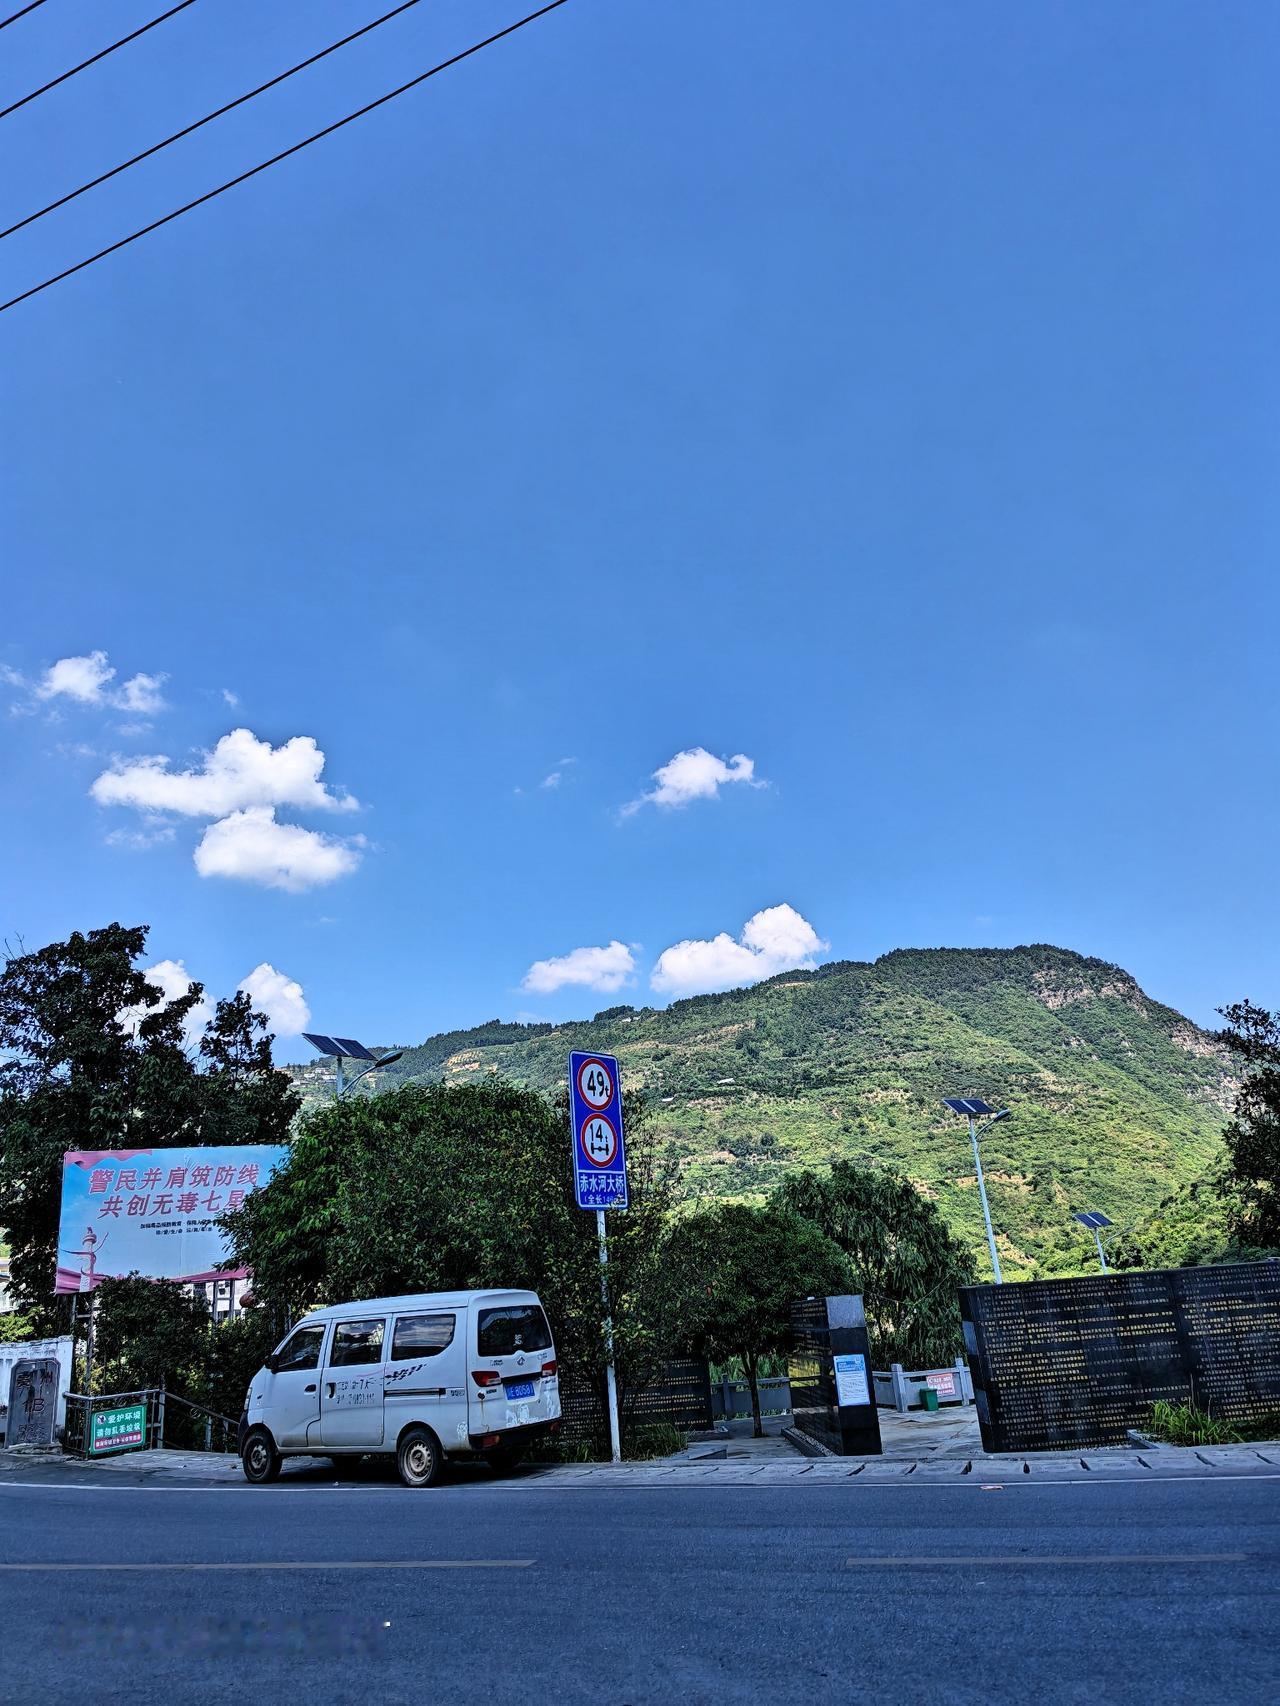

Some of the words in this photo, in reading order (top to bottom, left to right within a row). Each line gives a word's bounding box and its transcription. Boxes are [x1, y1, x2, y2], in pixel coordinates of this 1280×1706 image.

[89, 1164, 260, 1194] 警民并肩筑防线
[580, 1174, 624, 1193] 赤水河大桥
[97, 1190, 245, 1219] 共创无毒七星
[107, 1411, 141, 1424] 爱护环境
